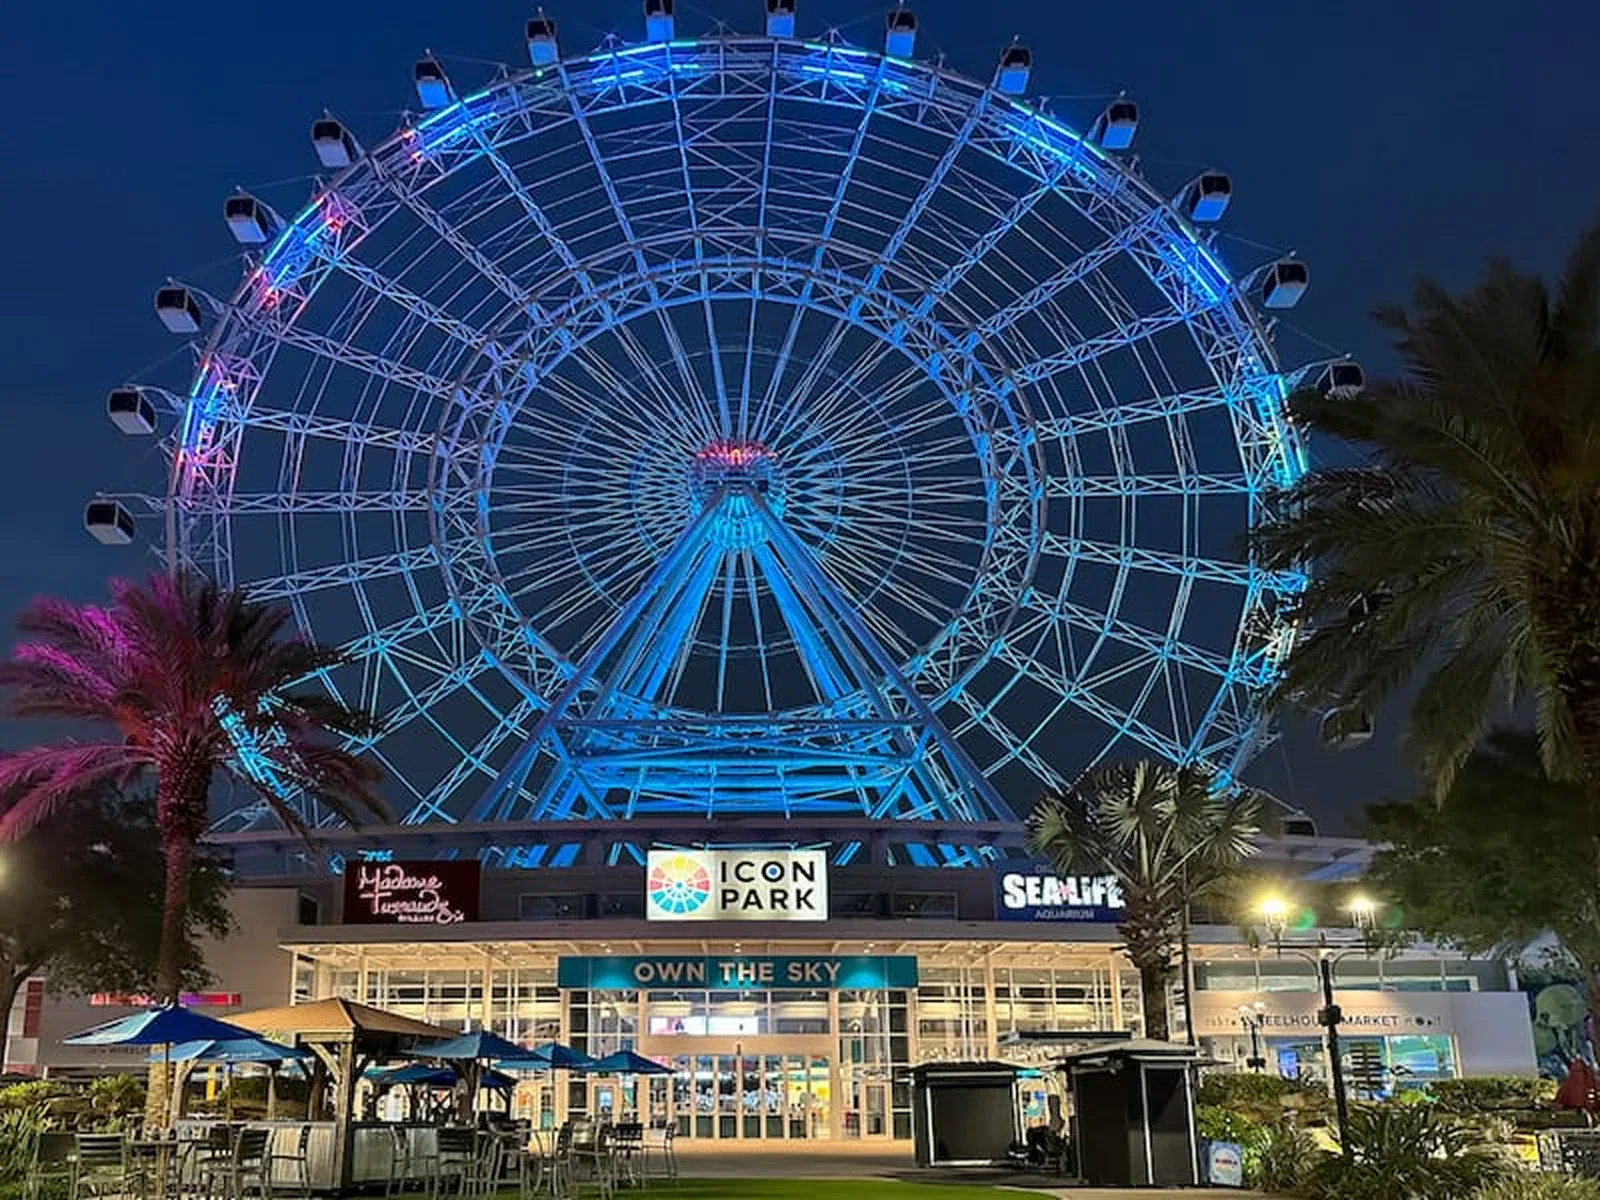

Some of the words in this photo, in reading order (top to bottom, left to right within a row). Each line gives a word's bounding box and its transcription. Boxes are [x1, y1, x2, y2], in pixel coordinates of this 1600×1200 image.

[358, 864, 443, 890] Madame
[721, 860, 815, 883] ICON
[721, 888, 815, 911] PARK
[1003, 873, 1062, 909] SEA
[1066, 875, 1126, 909] LIFE
[1034, 909, 1095, 920] AQUARIUM
[634, 963, 705, 983] OWN
[719, 962, 774, 983] THE
[787, 962, 841, 982] SKY
[1338, 1015, 1400, 1027] MARKET
